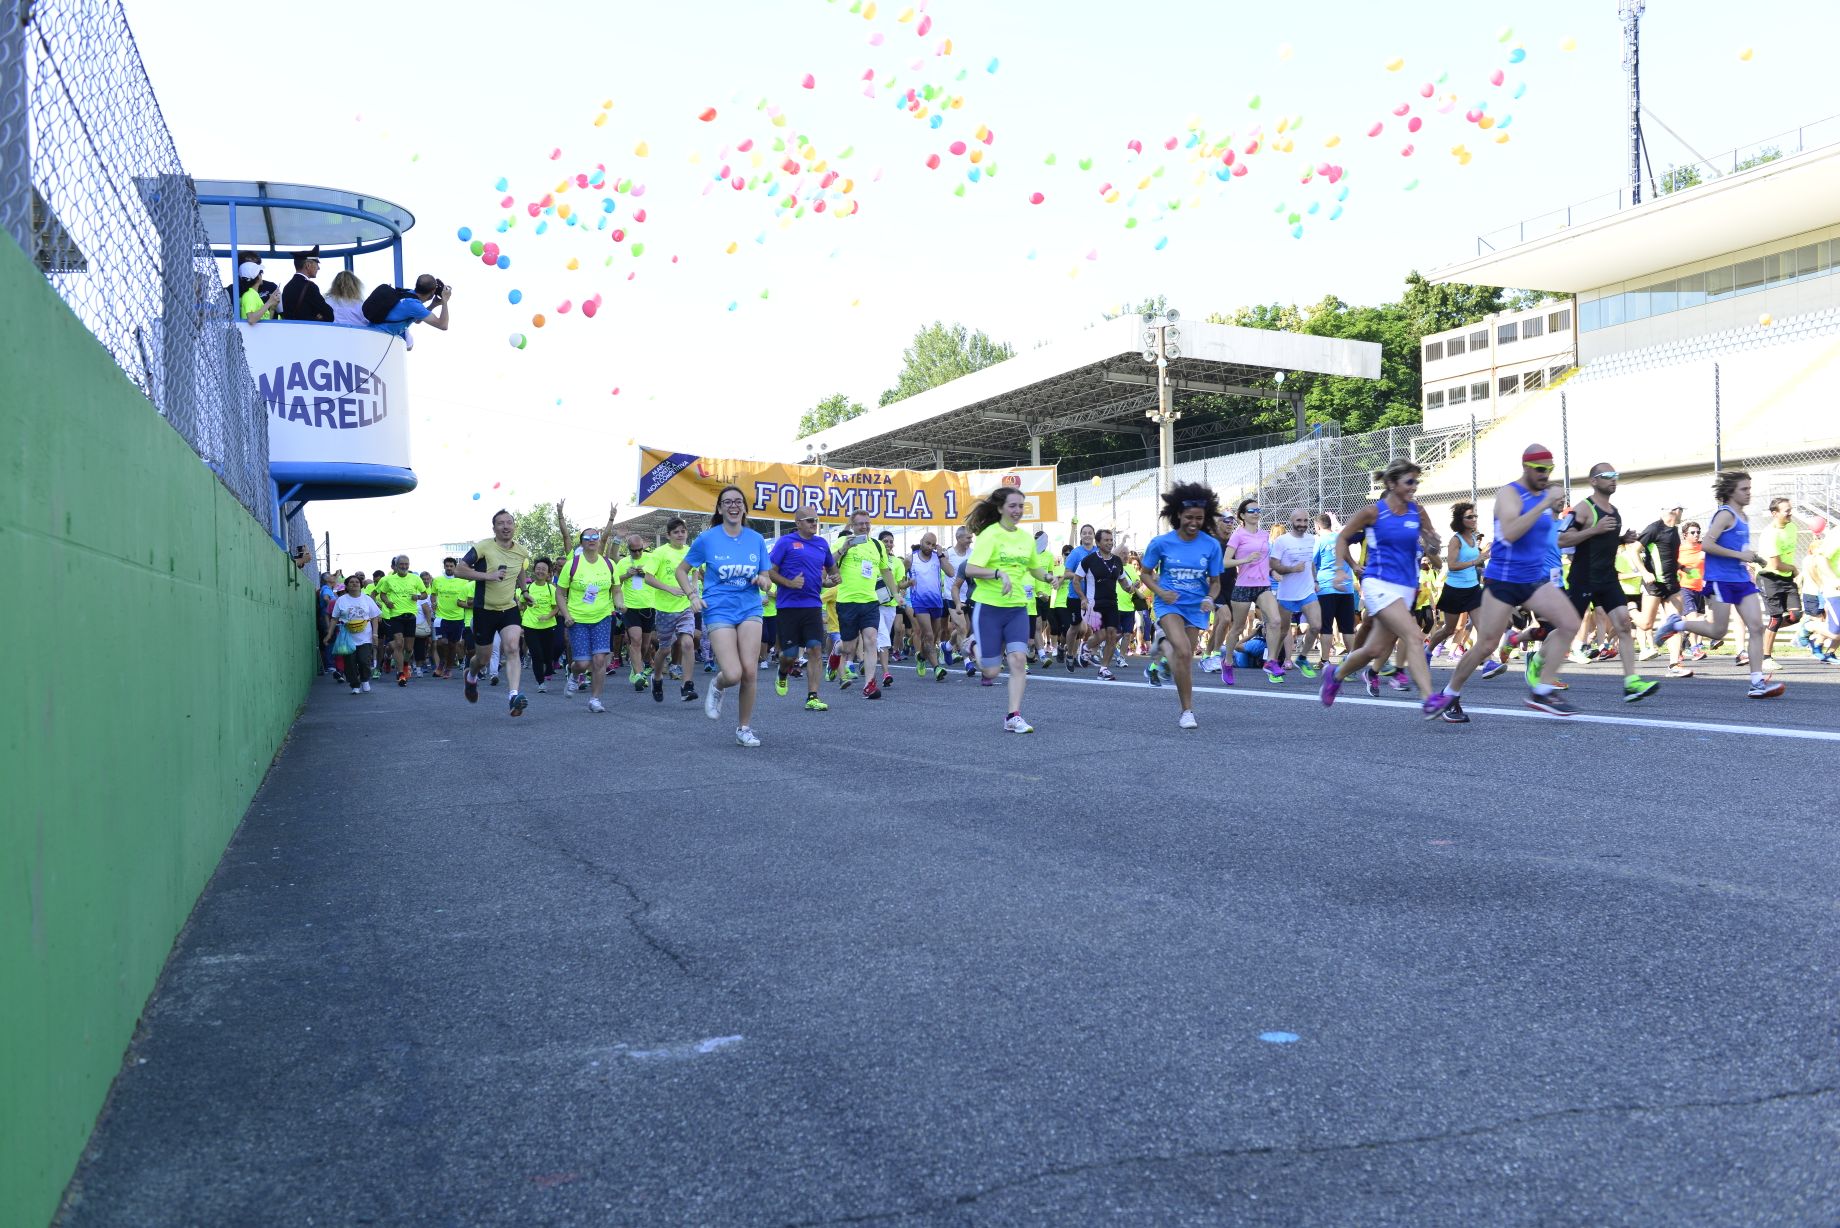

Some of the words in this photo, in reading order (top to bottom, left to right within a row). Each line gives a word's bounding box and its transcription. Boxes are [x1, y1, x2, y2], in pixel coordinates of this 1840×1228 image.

[259, 359, 387, 409] MAGNETI
[259, 384, 387, 429] MARELLI
[647, 481, 660, 493] NON
[660, 460, 689, 485] COMPETITIVA
[652, 460, 671, 475] MARCIA
[716, 474, 738, 484] LILT
[823, 472, 892, 485] PARTENZA
[752, 481, 933, 519] FORMULA
[945, 490, 958, 519] 1
[718, 565, 757, 579] STAFF
